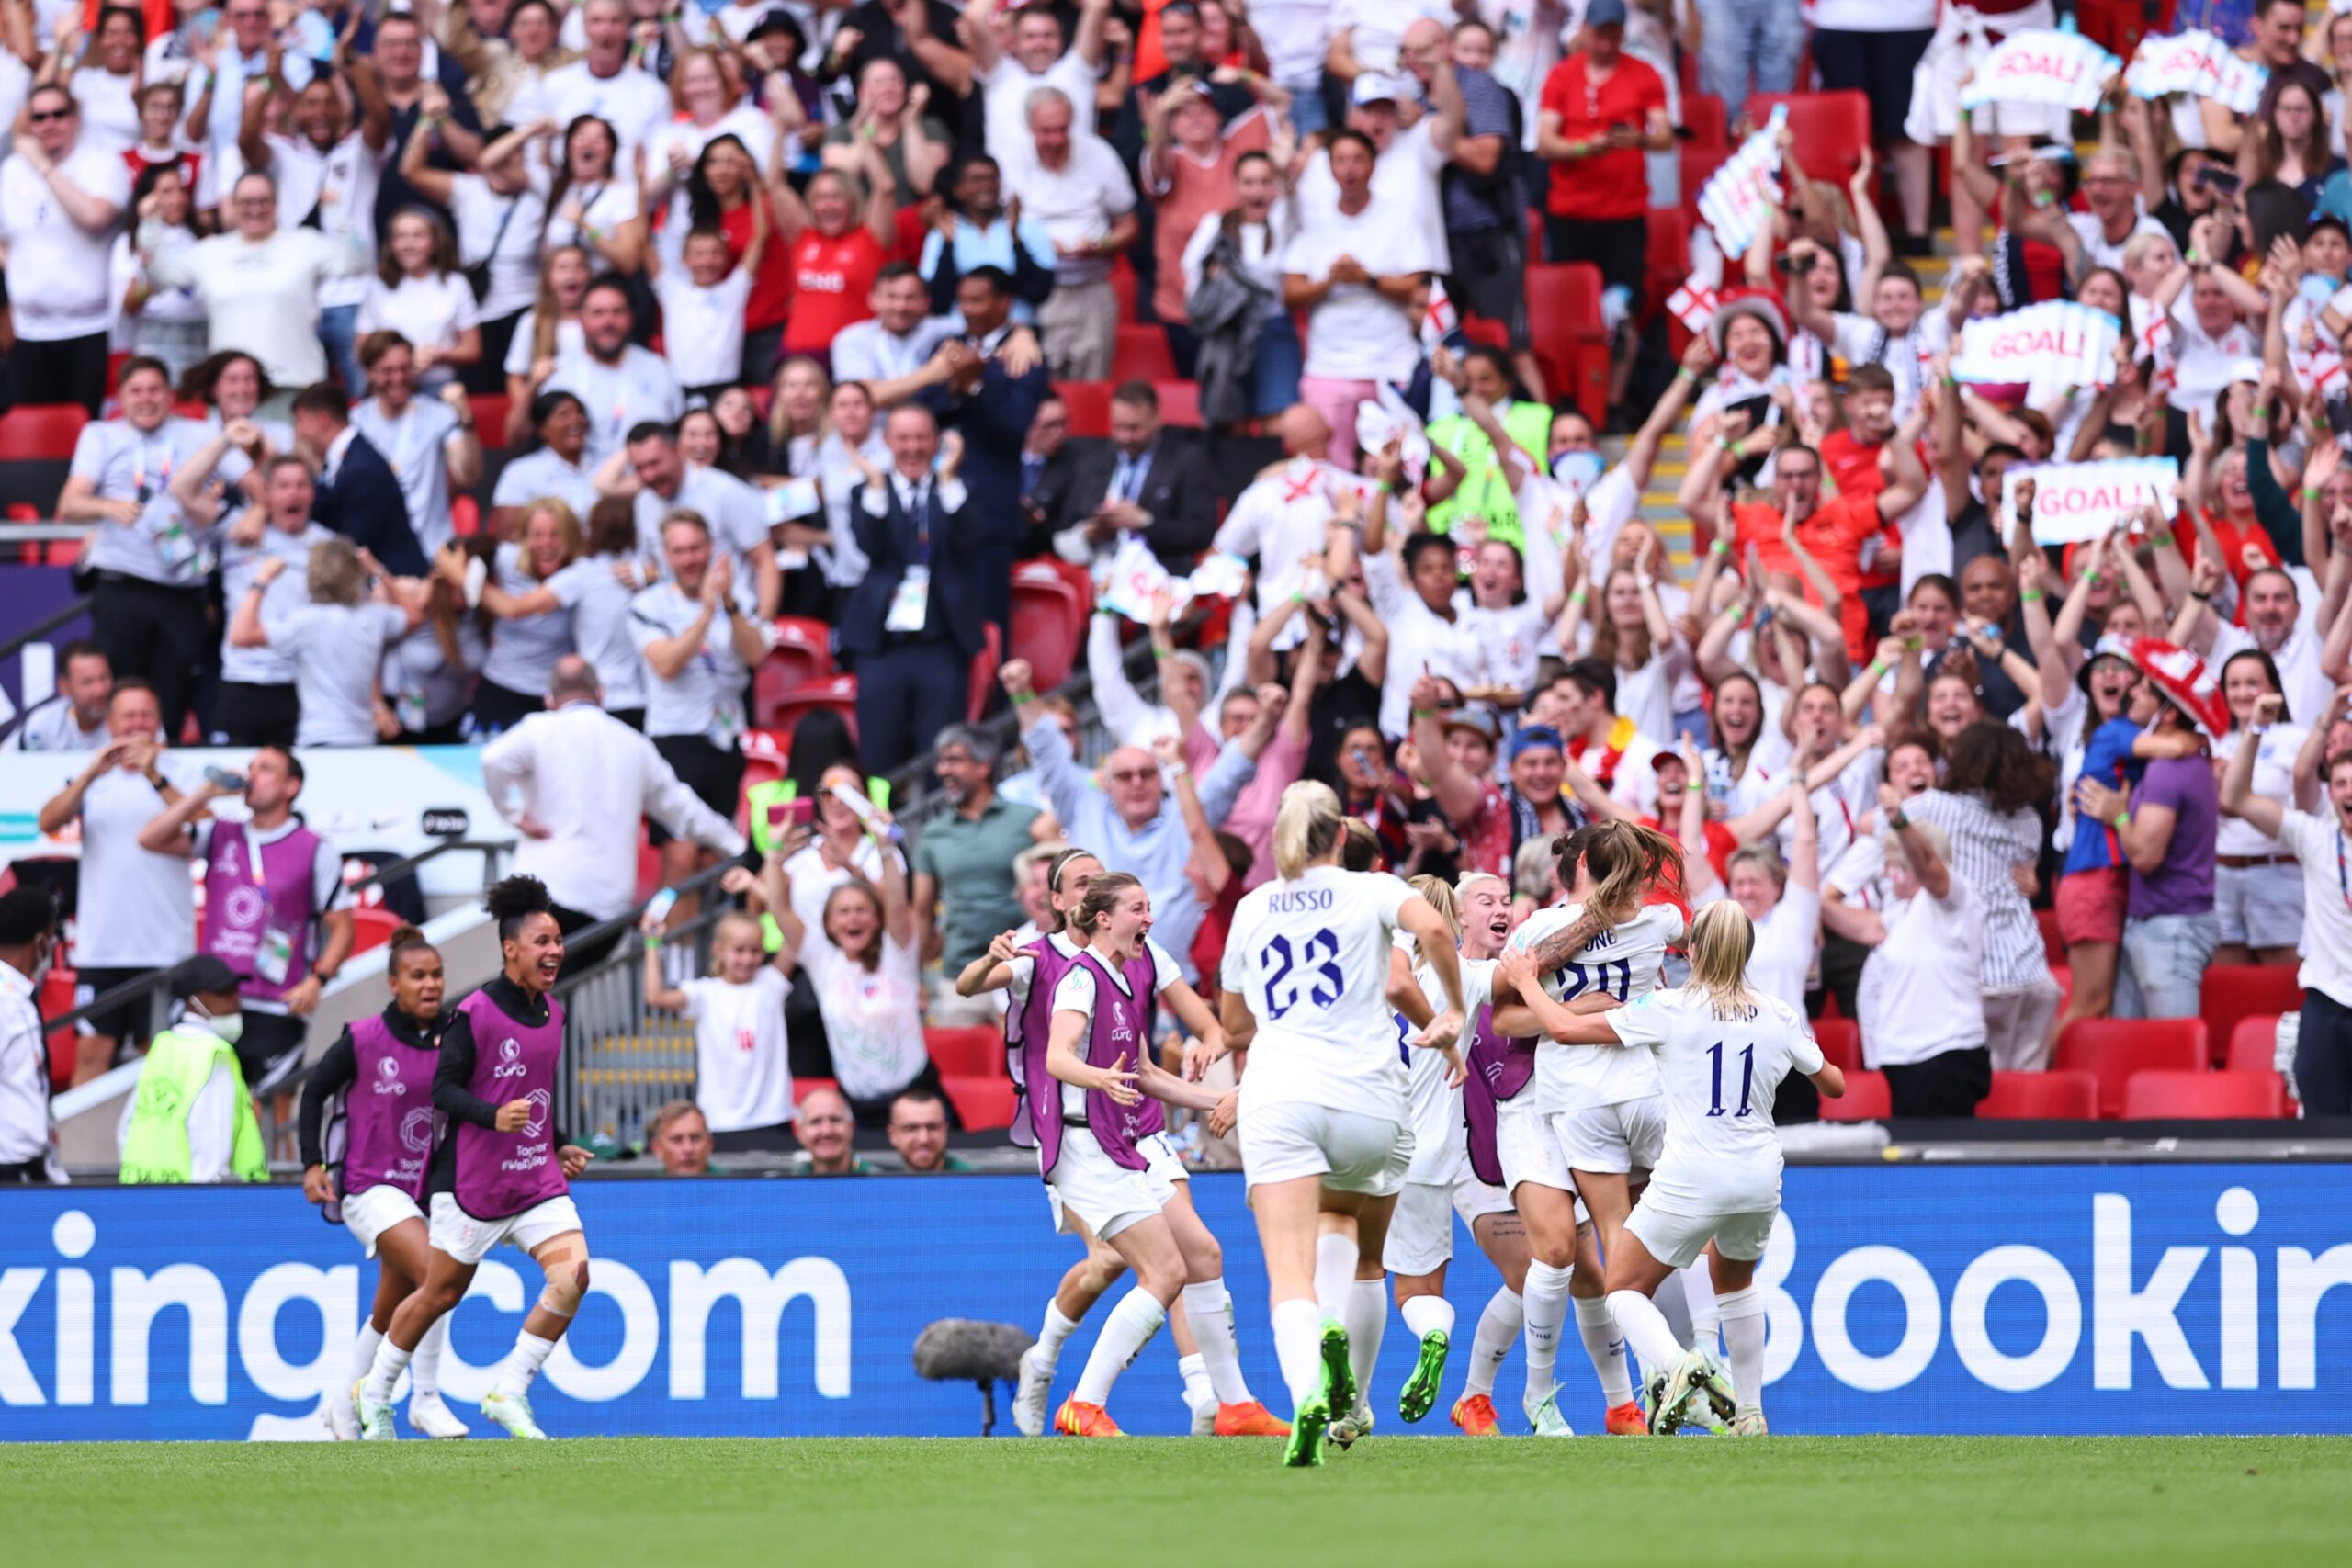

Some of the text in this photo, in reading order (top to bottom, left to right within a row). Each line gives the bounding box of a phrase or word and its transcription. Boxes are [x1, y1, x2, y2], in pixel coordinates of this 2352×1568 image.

[1990, 330, 2086, 359] GOAL!
[2038, 484, 2143, 516] GOAL!
[1269, 888, 1333, 914] RUSSO
[1261, 928, 1344, 1021] 23
[1555, 957, 1631, 1003] 20
[1711, 1001, 1758, 1023] HEMP
[1705, 1040, 1754, 1117] 11
[0, 1210, 852, 1440] ingcom
